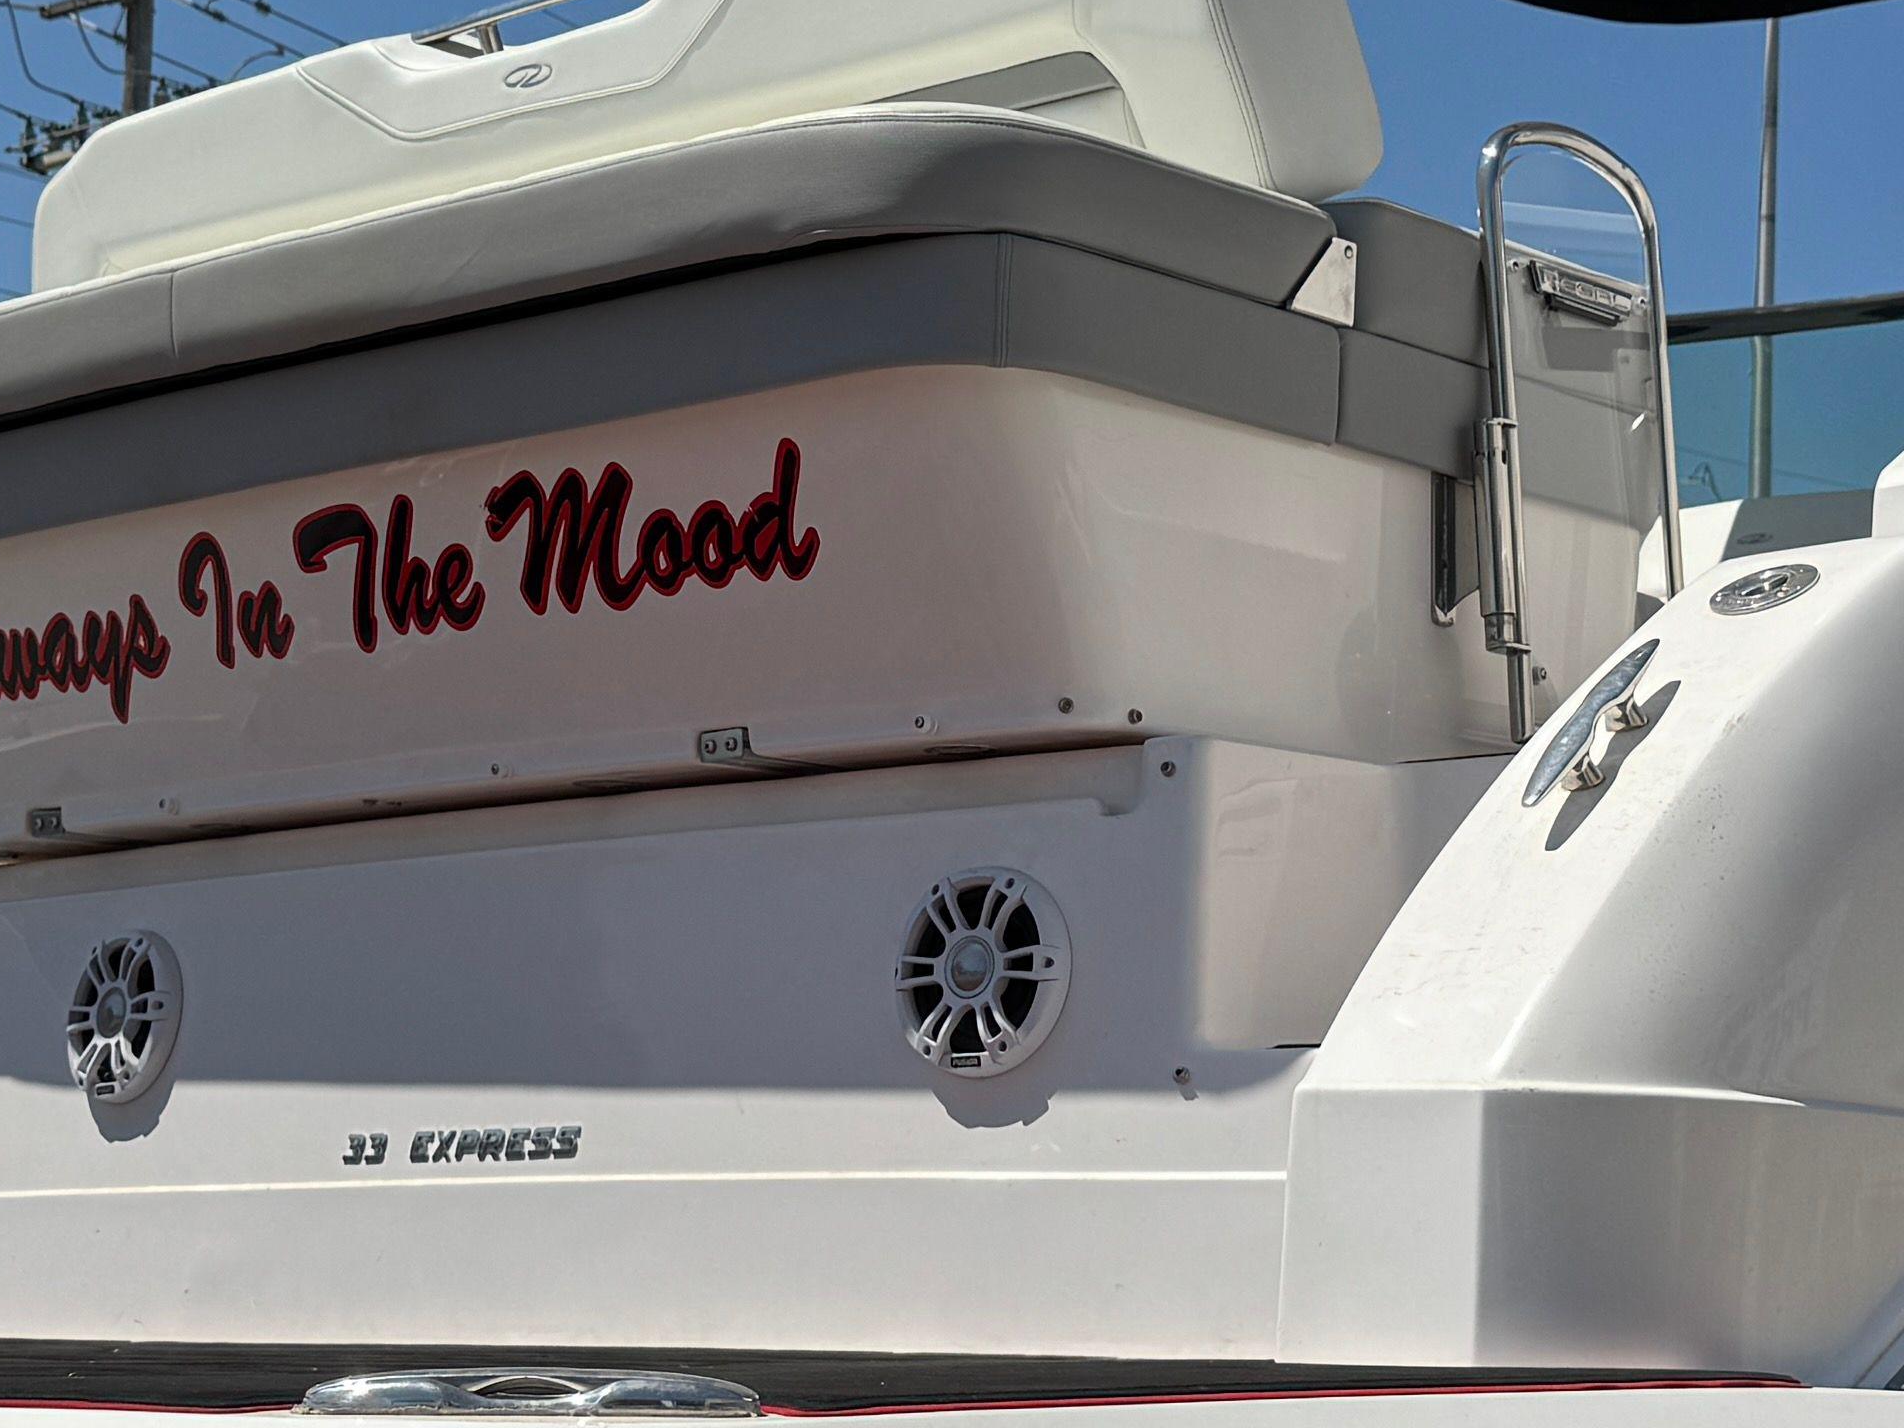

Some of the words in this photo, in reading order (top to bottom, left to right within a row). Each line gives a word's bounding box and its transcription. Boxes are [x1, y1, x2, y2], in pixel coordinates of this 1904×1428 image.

[179, 531, 295, 670] In
[293, 493, 486, 653] The
[486, 437, 821, 615] Mood
[342, 1132, 389, 1165] 33
[409, 1125, 583, 1164] EXPRESS
